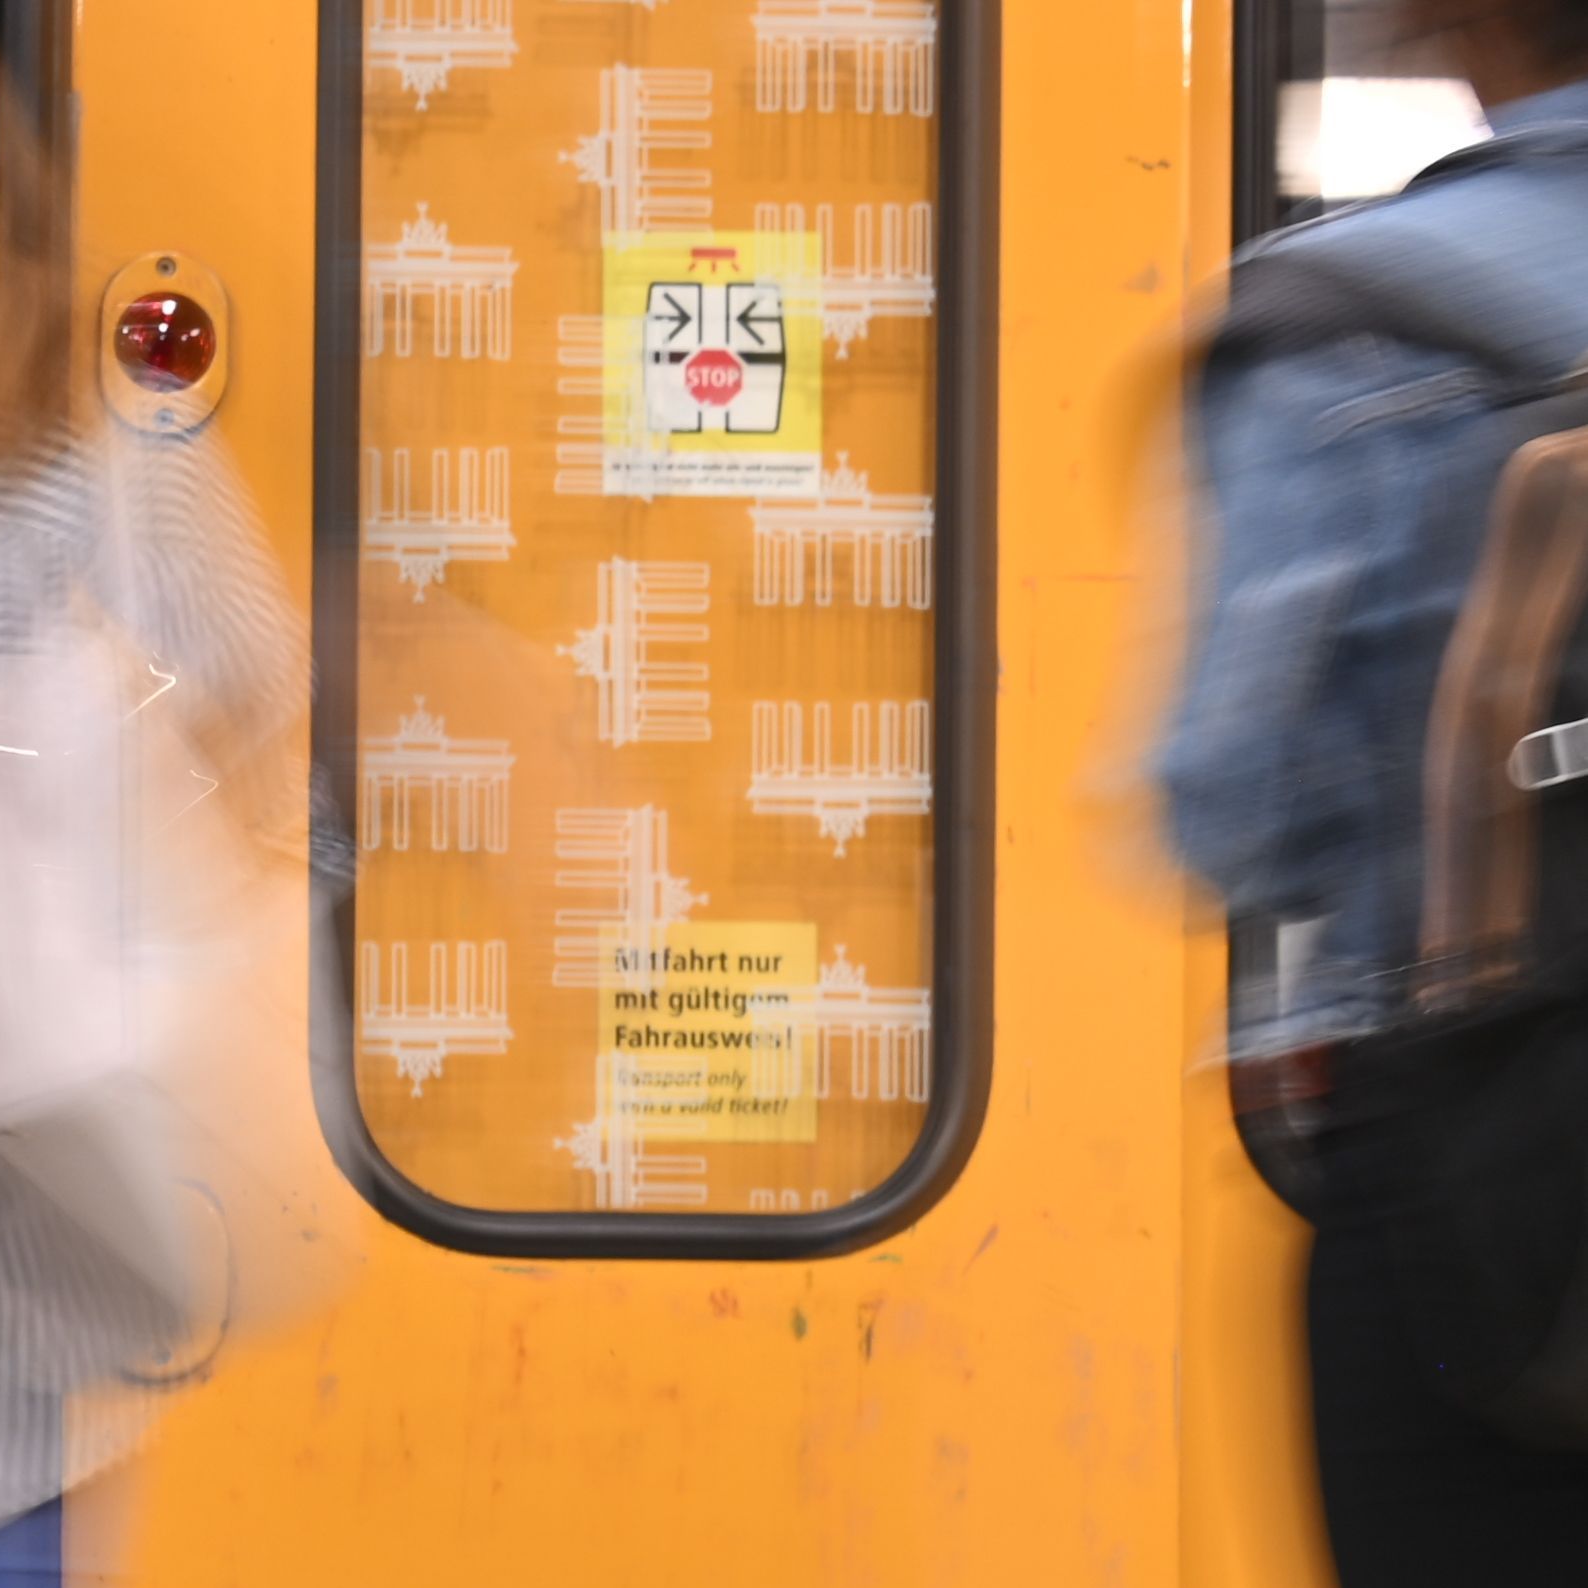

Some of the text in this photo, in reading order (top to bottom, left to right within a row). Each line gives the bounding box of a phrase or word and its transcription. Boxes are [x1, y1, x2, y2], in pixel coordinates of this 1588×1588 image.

[687, 366, 741, 389] STOP
[615, 947, 784, 974] Mtfahrt nur
[615, 988, 659, 1011] mit
[707, 1069, 749, 1090] only
[728, 1097, 790, 1115] ticket!
